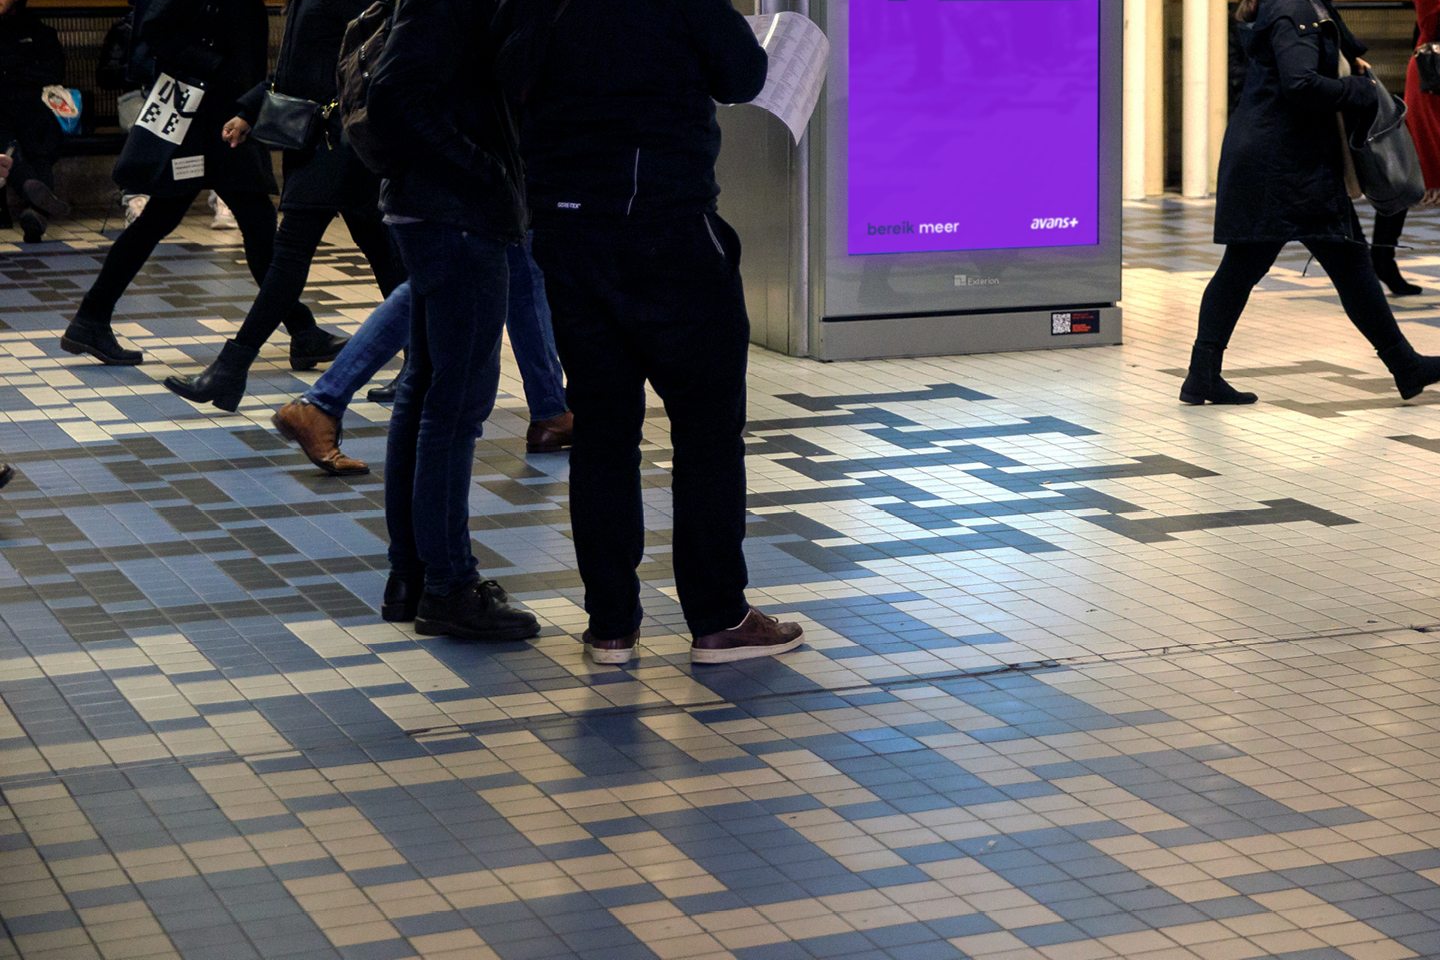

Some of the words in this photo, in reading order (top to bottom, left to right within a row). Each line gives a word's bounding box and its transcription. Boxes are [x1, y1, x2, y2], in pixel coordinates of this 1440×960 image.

[867, 221, 914, 236] bereik
[919, 221, 960, 234] meer
[1030, 216, 1079, 230] avans+
